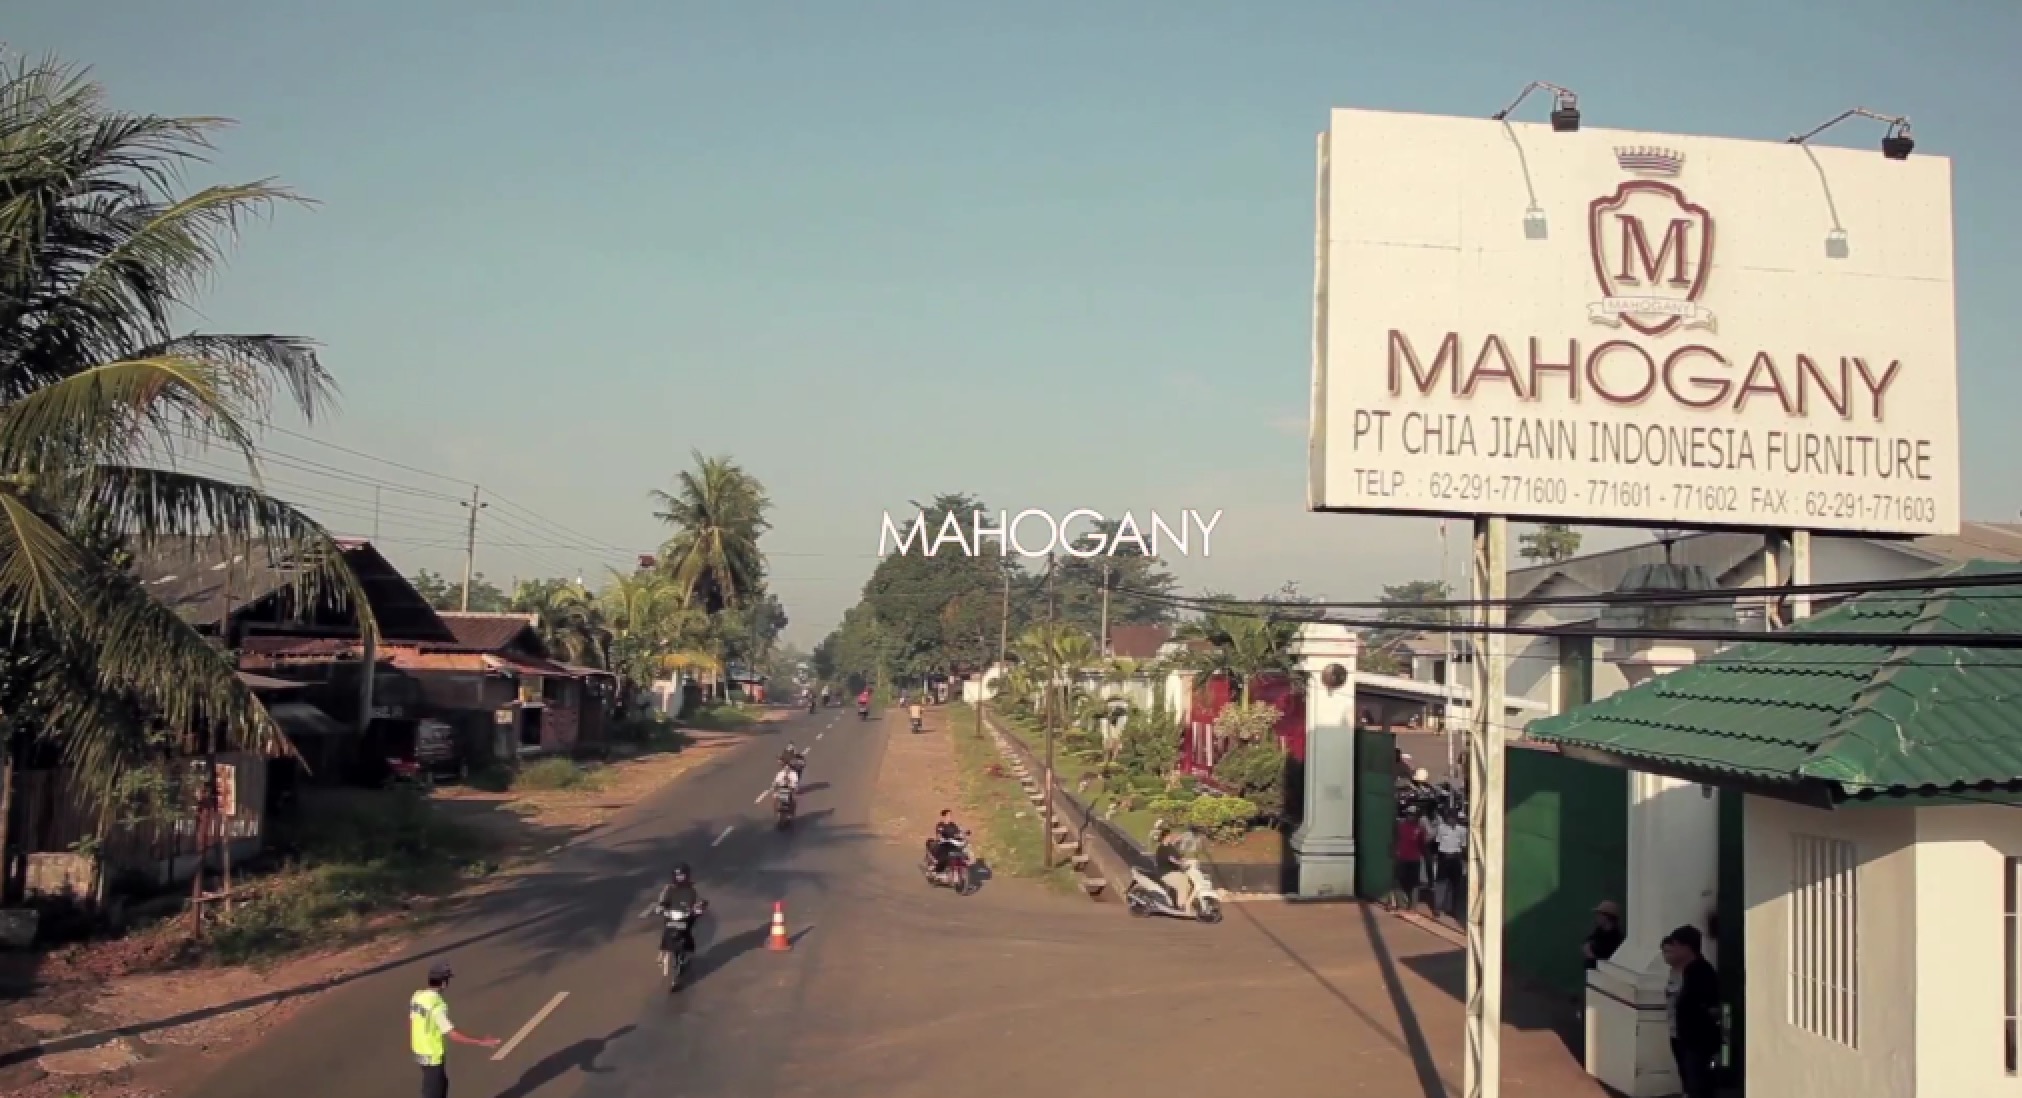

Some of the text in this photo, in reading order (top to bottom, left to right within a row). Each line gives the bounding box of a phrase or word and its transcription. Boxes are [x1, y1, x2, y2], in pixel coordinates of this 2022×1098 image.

[1614, 214, 1693, 286] M
[1609, 300, 1692, 315] MAHOGANY
[1388, 329, 1900, 420] MAHOGANY
[1353, 409, 1932, 480] PT CHIA JIANN INDONESIA FURNITURE
[1429, 471, 1567, 504] 62-291-771600
[1587, 479, 1651, 507] 771601
[1673, 483, 1737, 511] 771602
[1805, 490, 1936, 523] 62-291-771603
